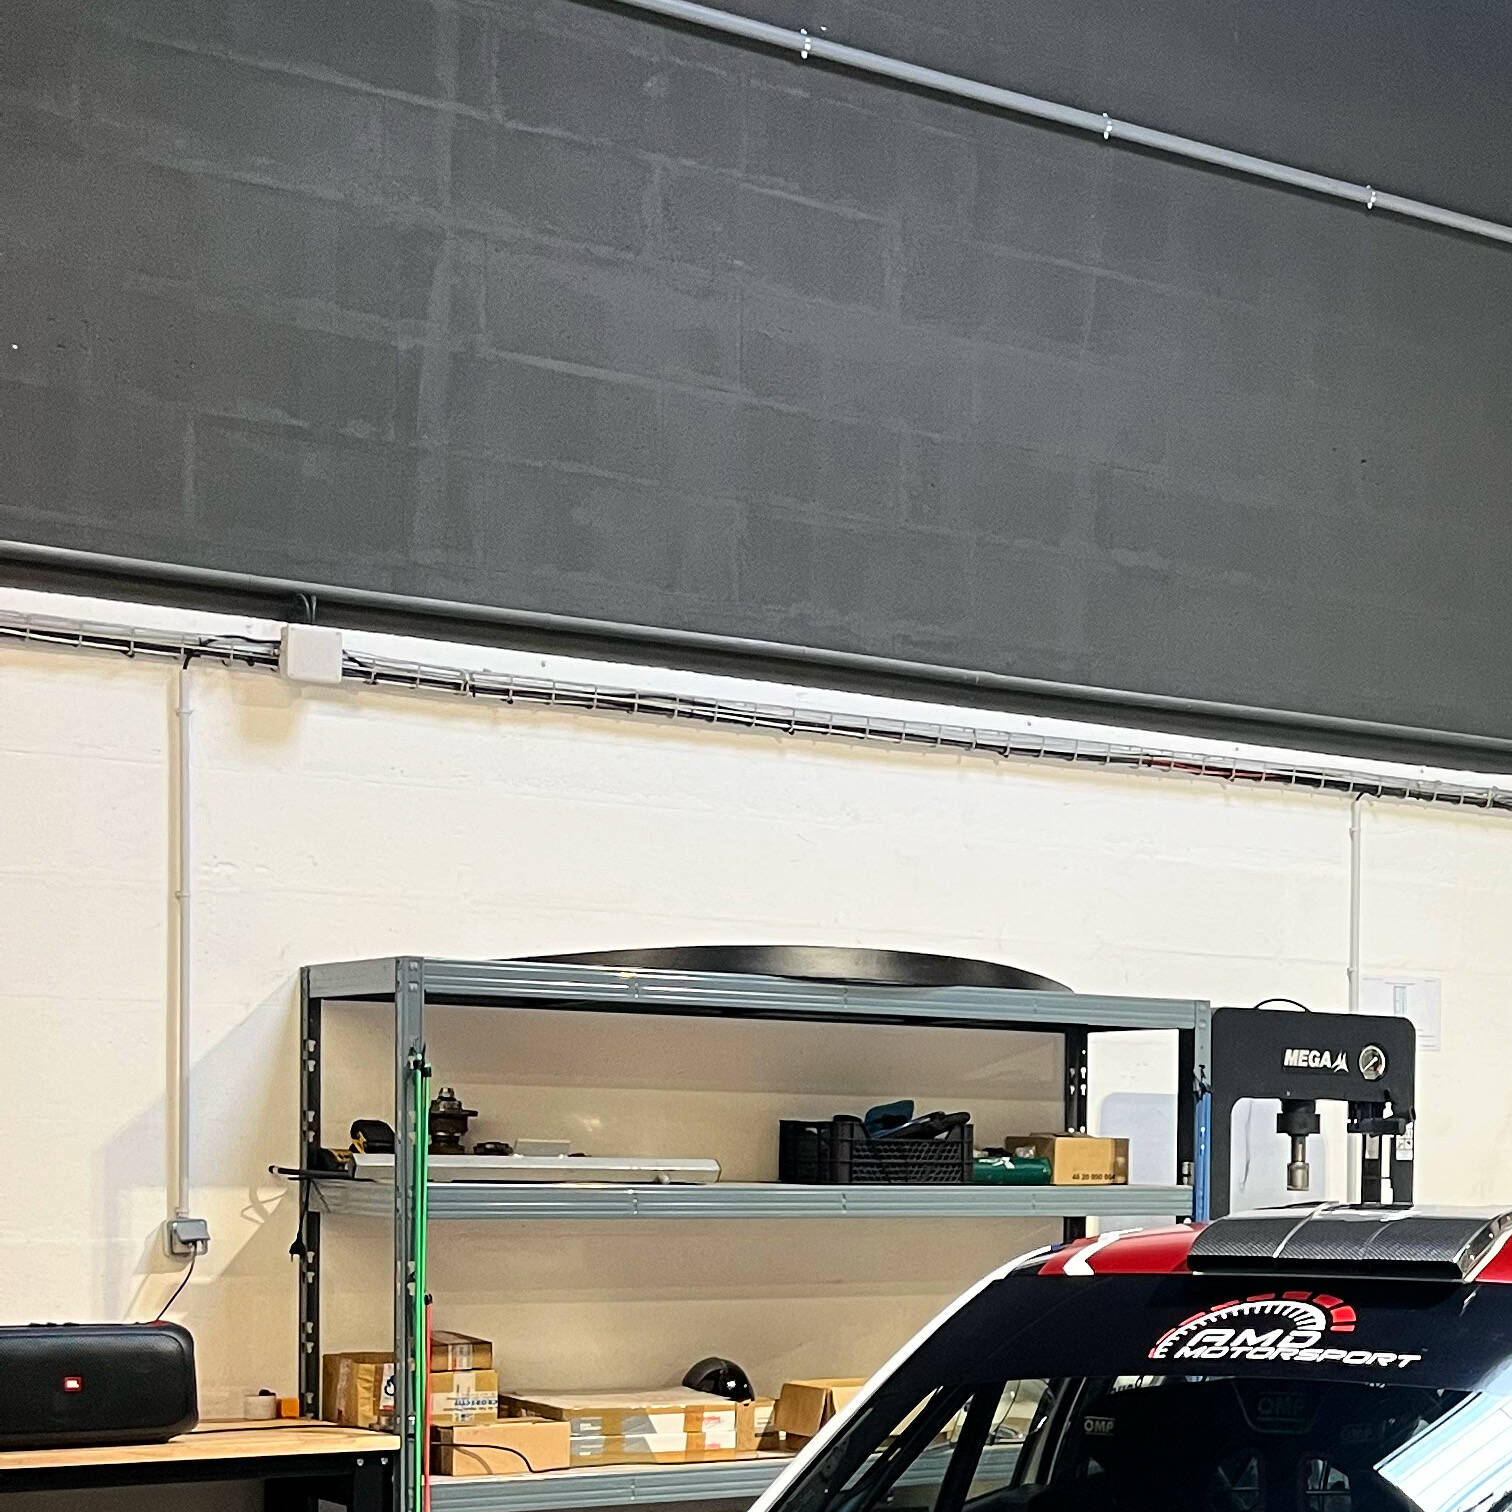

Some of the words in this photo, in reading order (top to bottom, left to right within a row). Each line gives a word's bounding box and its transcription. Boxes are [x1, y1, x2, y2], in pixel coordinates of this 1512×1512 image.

[1283, 1049, 1332, 1069] MEGA
[1187, 1328, 1322, 1349] AMD
[1173, 1346, 1422, 1368] MOTORSPORT
[1084, 1419, 1114, 1432] OMP
